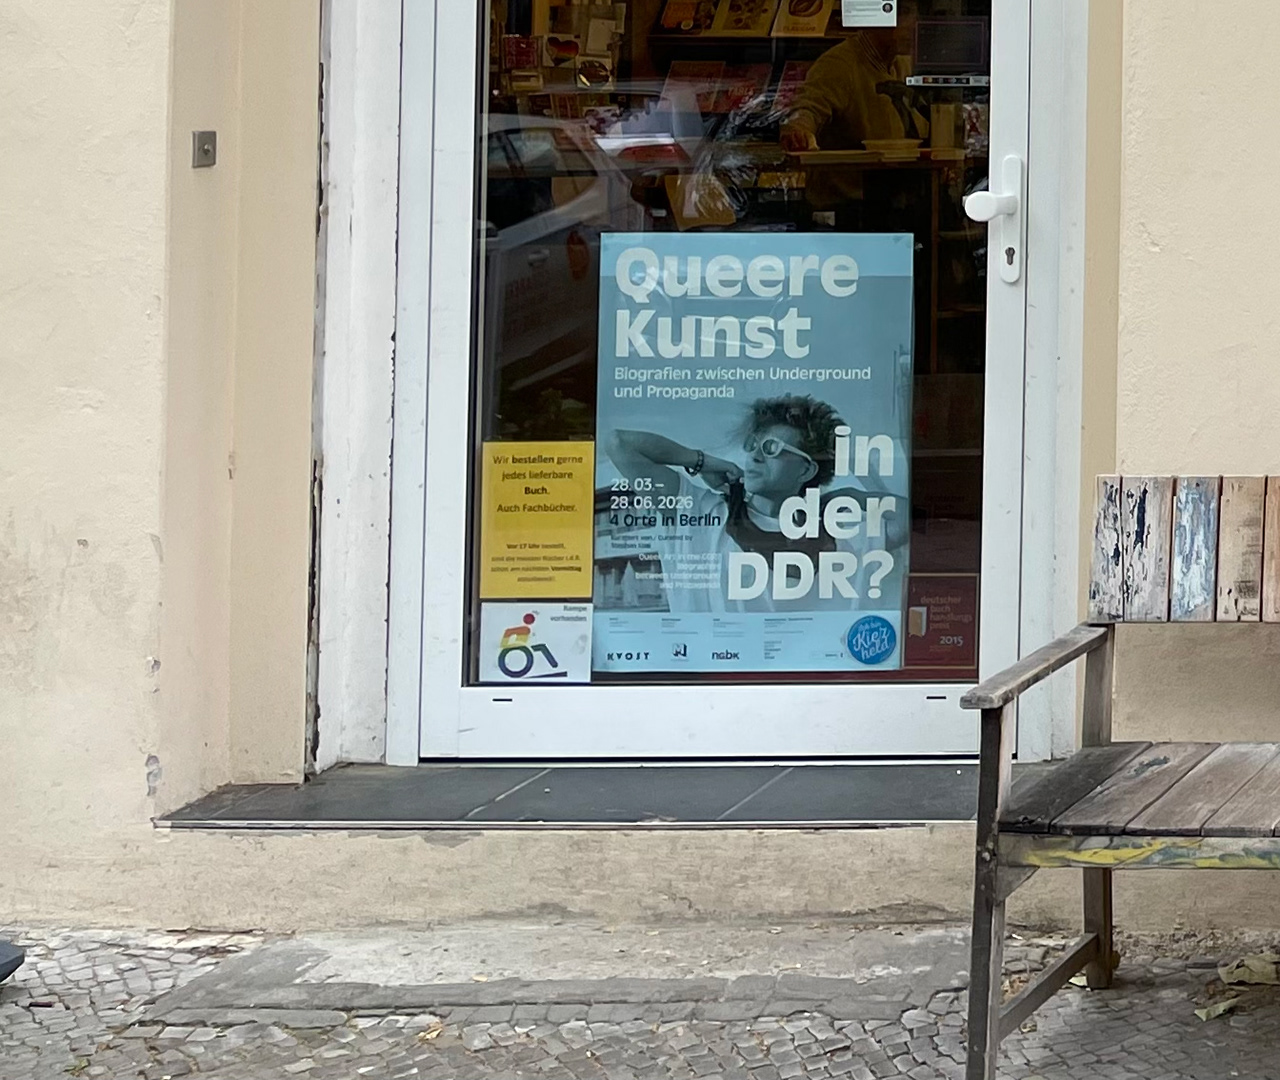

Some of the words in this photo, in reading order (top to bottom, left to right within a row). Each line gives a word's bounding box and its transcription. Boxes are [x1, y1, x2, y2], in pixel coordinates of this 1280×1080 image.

[615, 246, 858, 303] Queere
[615, 308, 811, 359] Kunst
[614, 367, 691, 382] Biografien
[696, 367, 765, 380] zwischen
[770, 367, 871, 382] Underground
[614, 385, 642, 398] und
[647, 385, 734, 400] Propaganda
[834, 425, 894, 476] in
[493, 455, 509, 464] Wir
[512, 455, 554, 464] bestellen
[556, 456, 583, 465] gerne
[502, 470, 526, 480] jedes
[528, 470, 573, 479] lieferbare
[524, 486, 550, 495] Buch.
[497, 503, 520, 513] Auch
[523, 503, 577, 513] Fachbücher.
[779, 485, 896, 539] der
[609, 514, 619, 526] 4
[623, 514, 657, 526] Orte
[661, 514, 674, 526] in
[680, 514, 721, 526] Berlin
[728, 550, 894, 601] DDR?
[852, 625, 890, 651] Kiez
[940, 636, 963, 646] 2015
